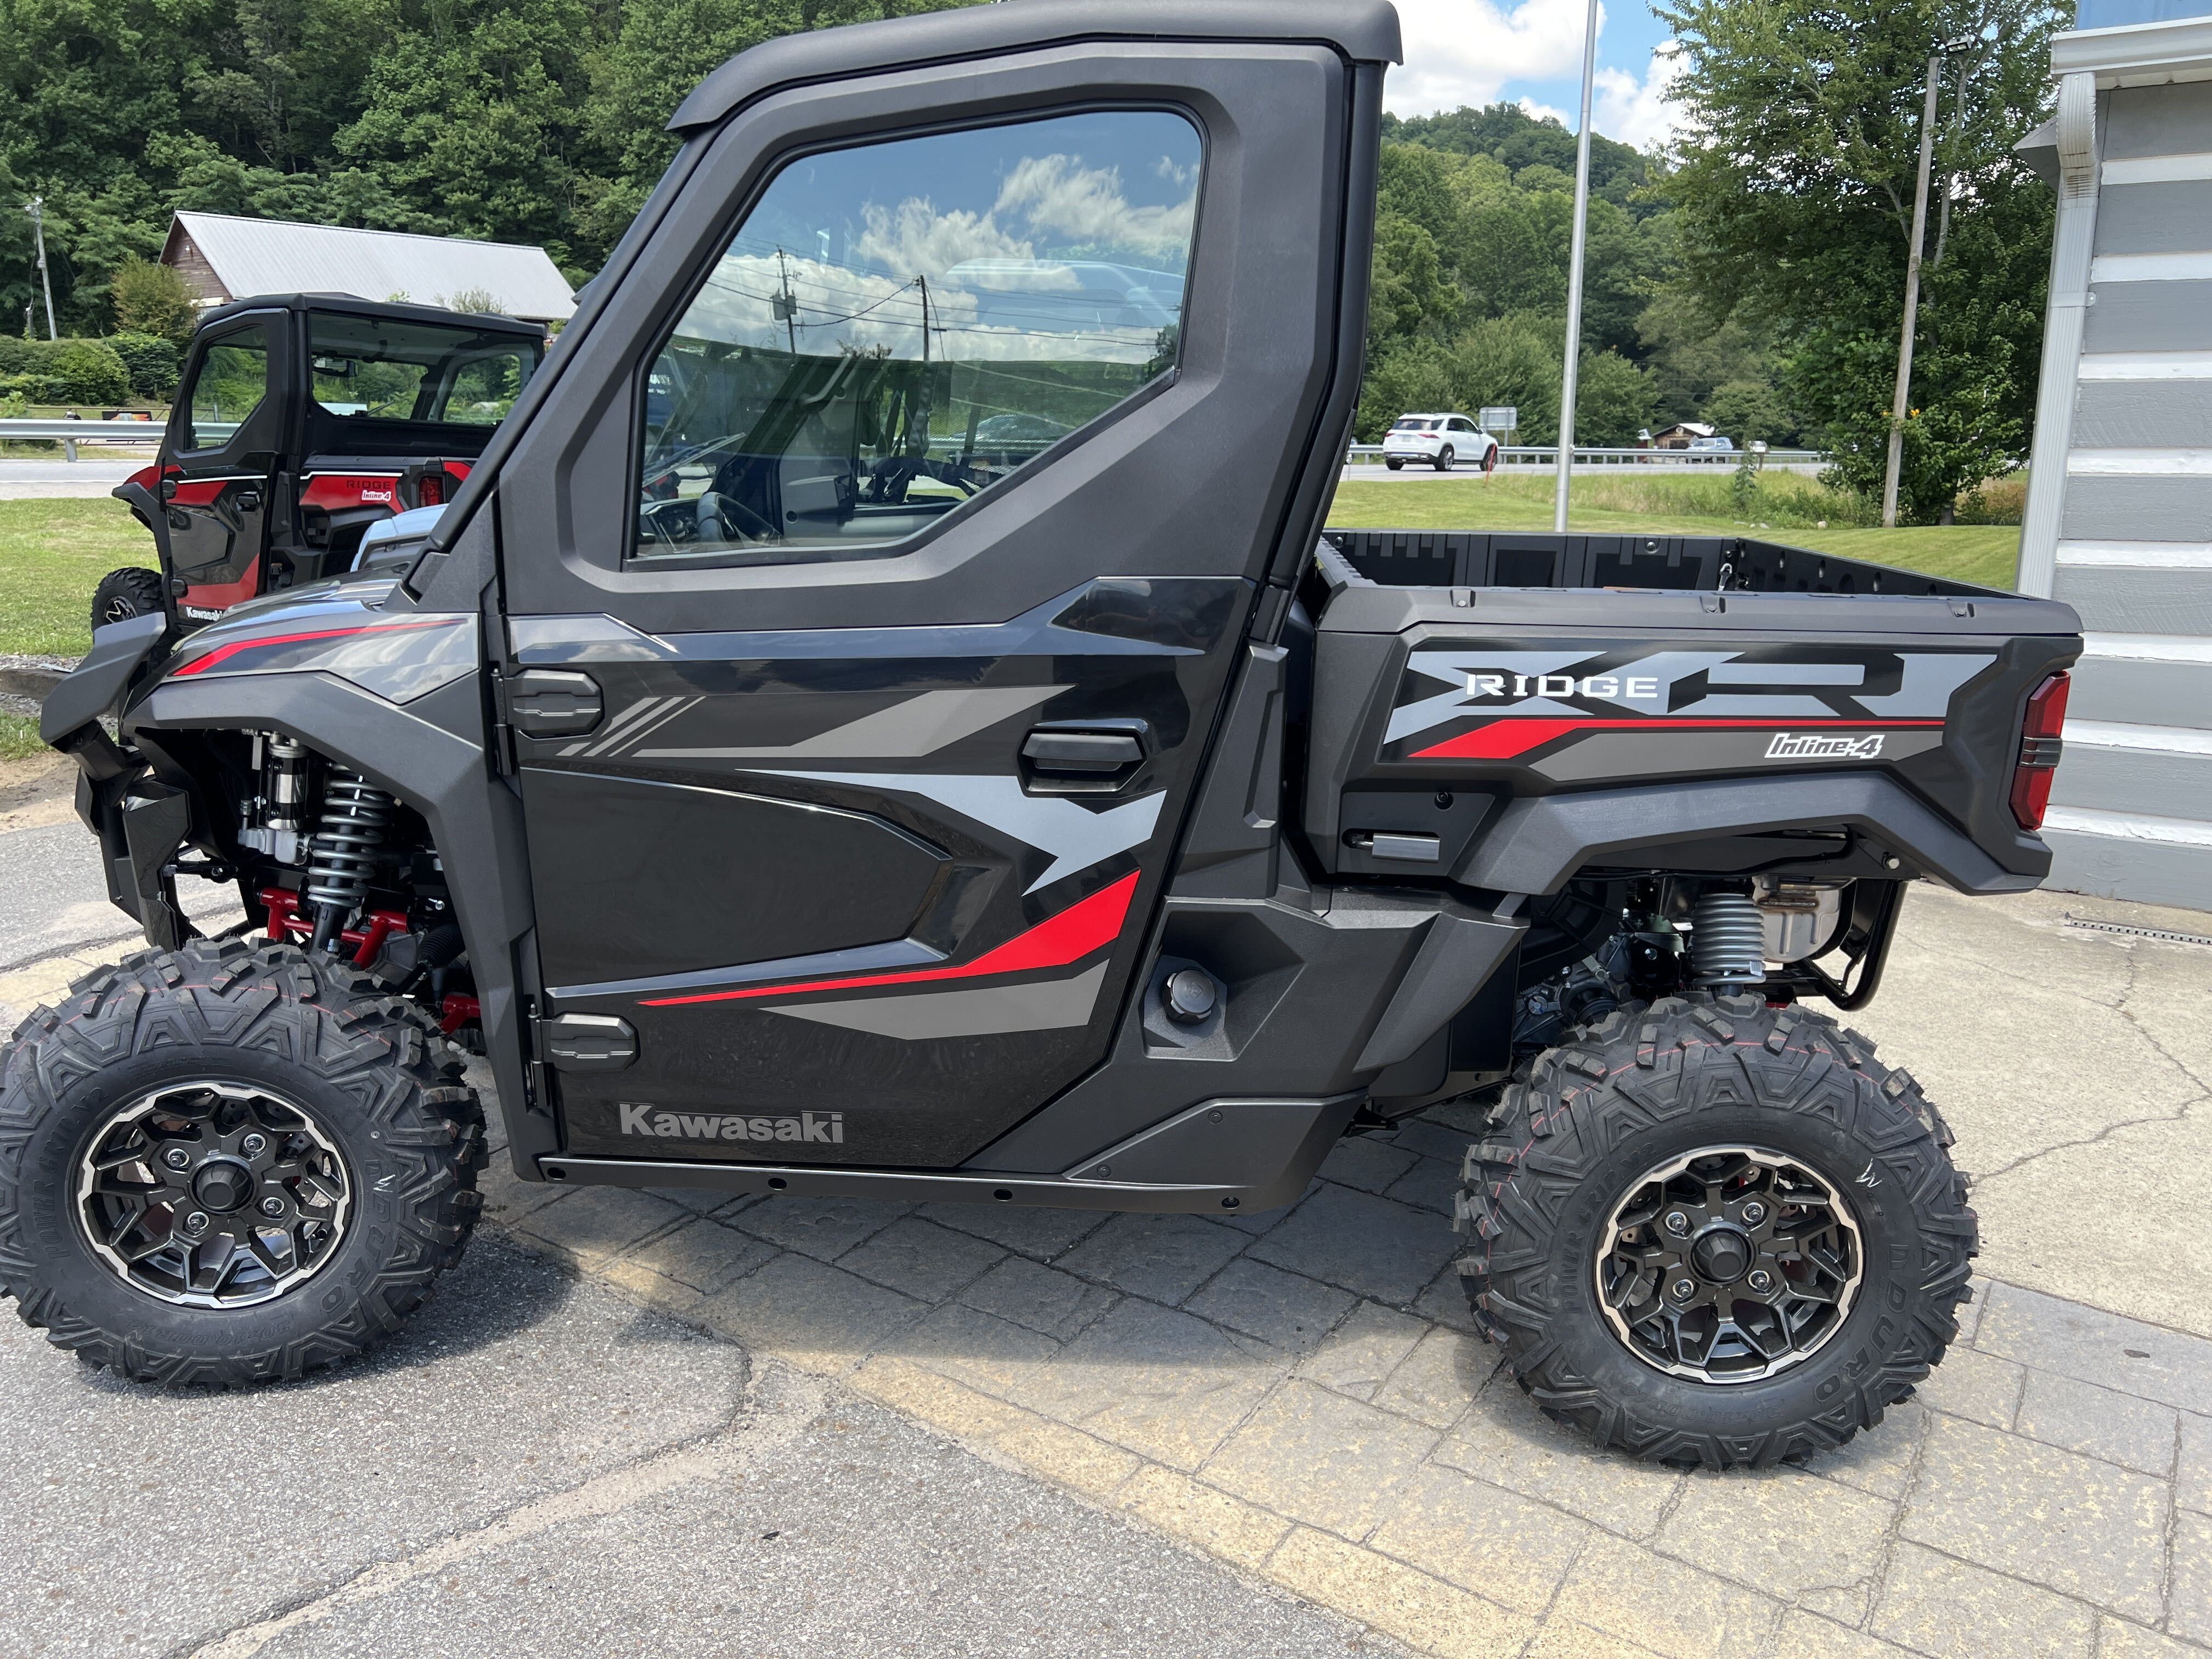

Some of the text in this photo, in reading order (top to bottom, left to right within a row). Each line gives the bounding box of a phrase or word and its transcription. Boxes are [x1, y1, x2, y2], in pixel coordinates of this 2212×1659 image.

[346, 480, 391, 489] RIDGE
[1466, 674, 1658, 698] RIDGE
[1764, 733, 1885, 759] Inline-4
[619, 1103, 844, 1143] Kawasaki
[33, 1179, 71, 1259] POWER
[321, 1193, 391, 1313] DURO
[1813, 1278, 1907, 1403] DURO
